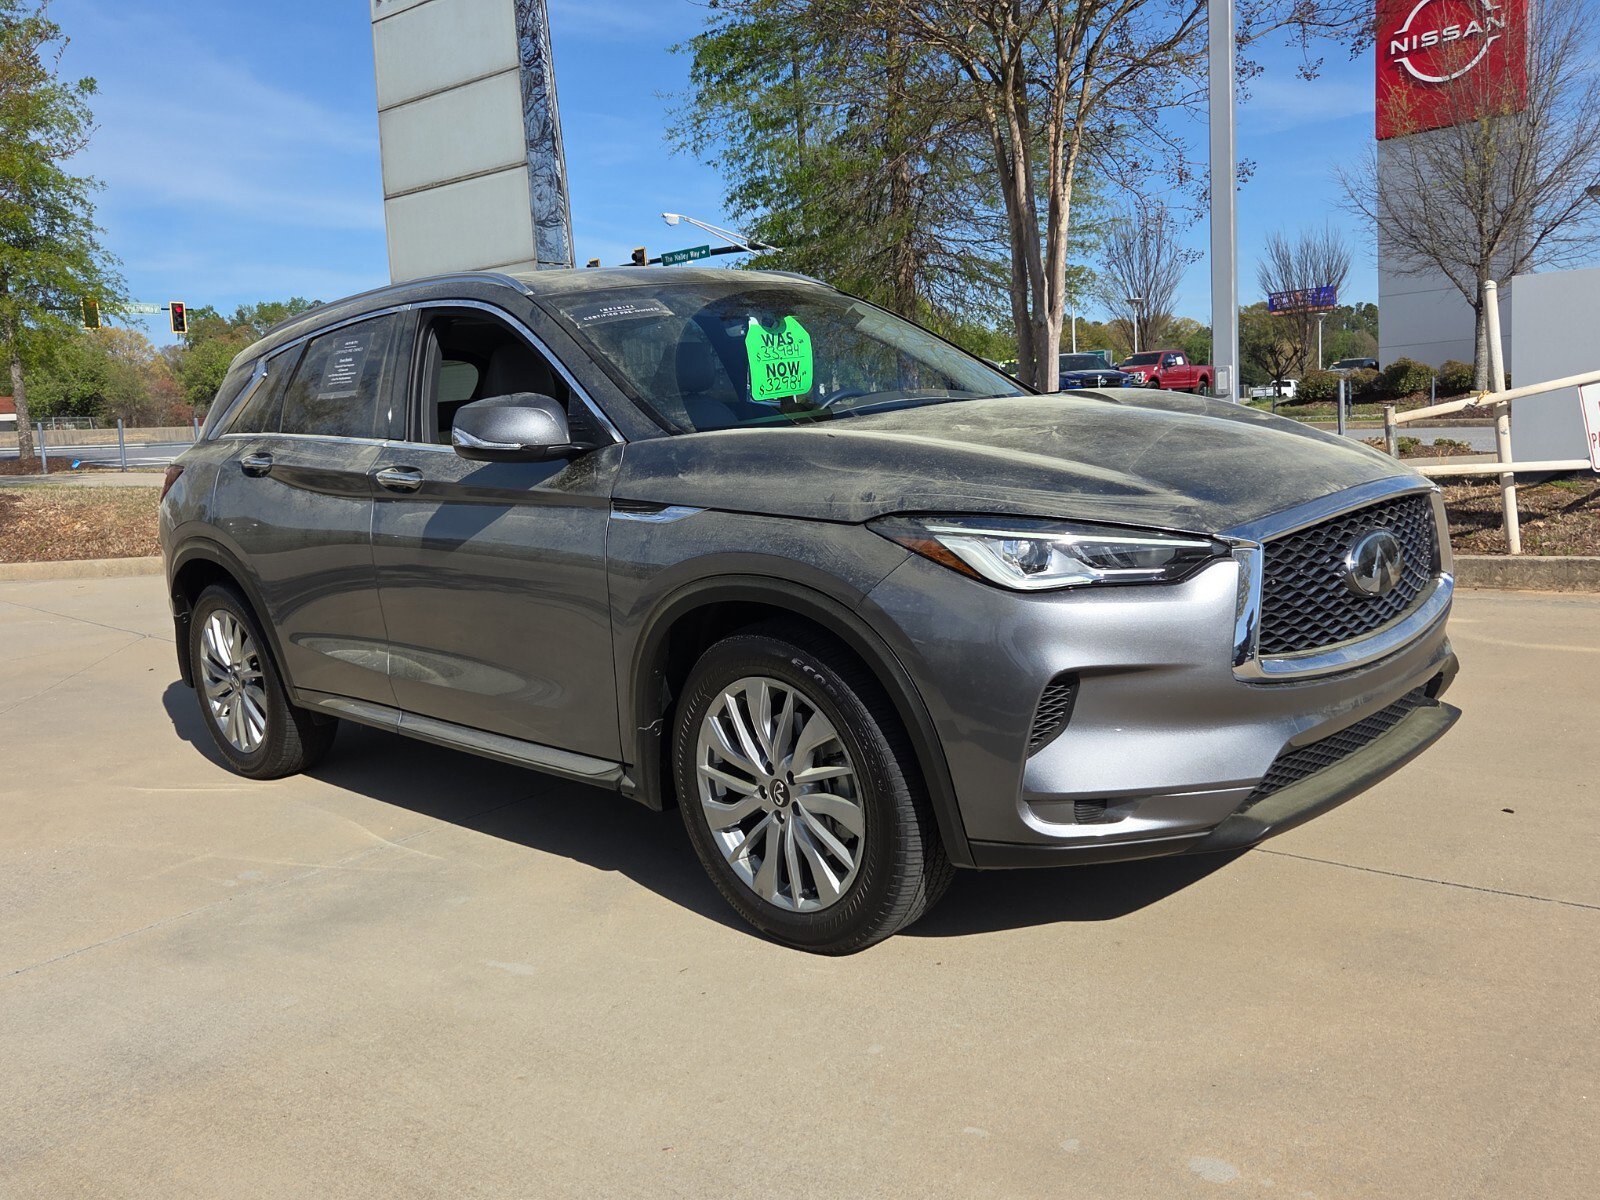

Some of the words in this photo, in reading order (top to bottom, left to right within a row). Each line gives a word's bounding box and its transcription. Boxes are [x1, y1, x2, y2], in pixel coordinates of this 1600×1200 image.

[1390, 13, 1505, 55] NISSAN
[689, 250, 700, 258] Way
[583, 311, 618, 321] CERTIFIED
[619, 306, 660, 315] PRE-OWNED
[761, 332, 794, 347] WAS
[765, 361, 800, 379] NOW
